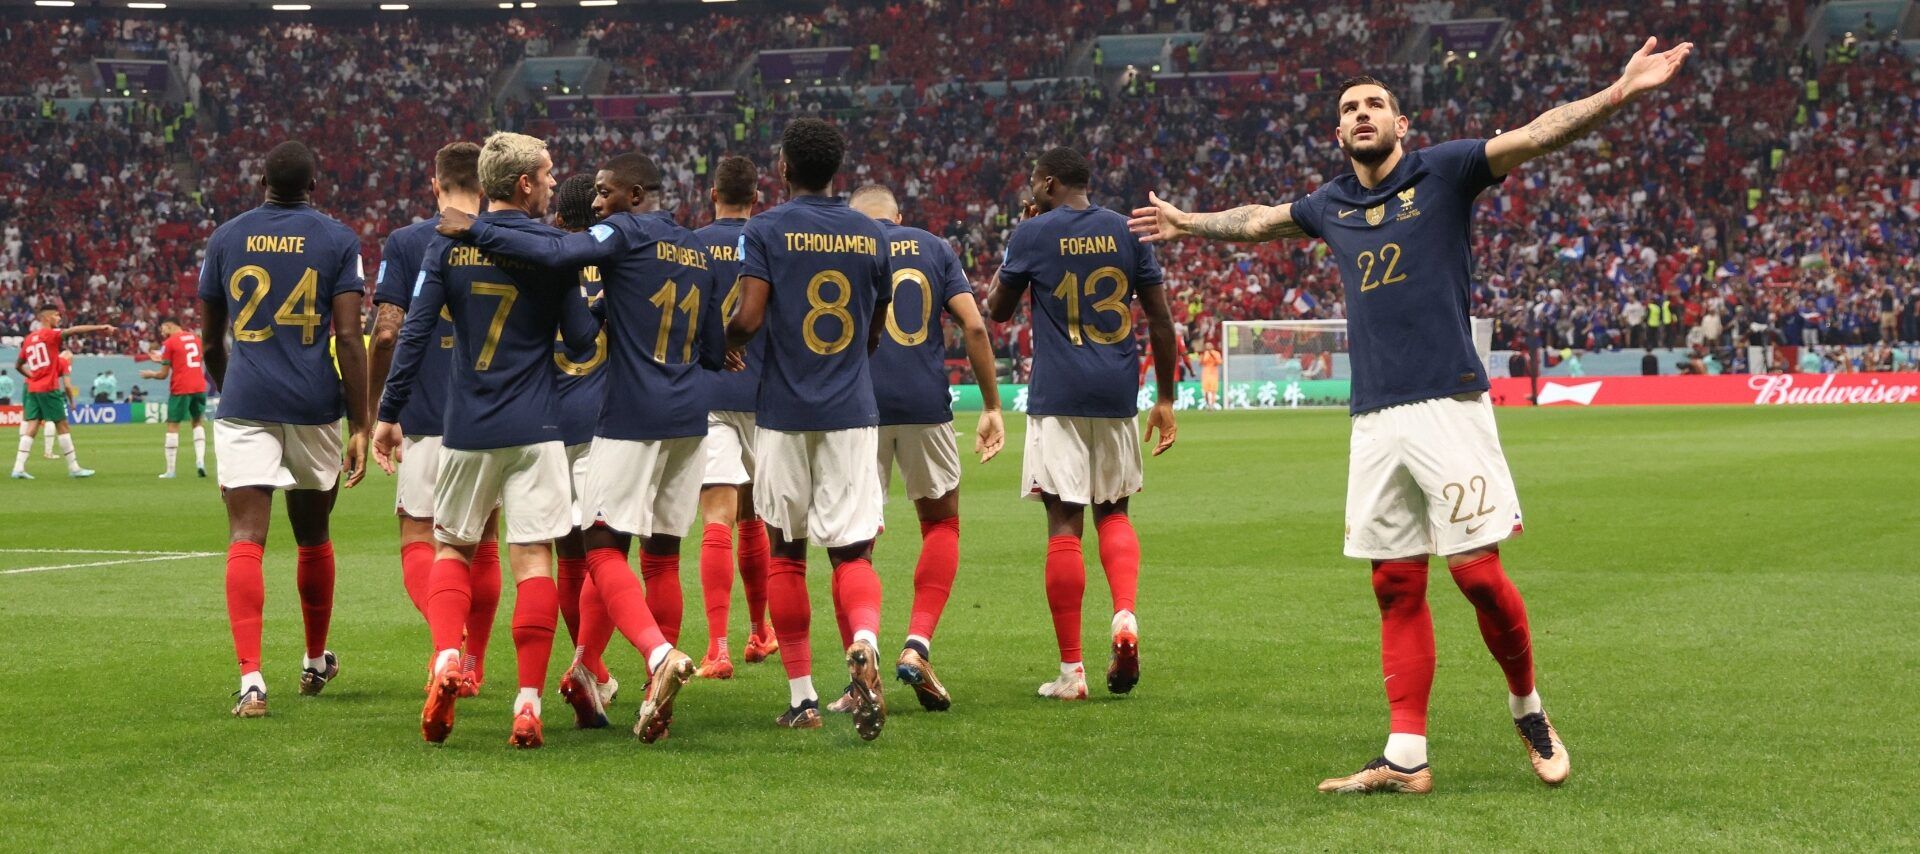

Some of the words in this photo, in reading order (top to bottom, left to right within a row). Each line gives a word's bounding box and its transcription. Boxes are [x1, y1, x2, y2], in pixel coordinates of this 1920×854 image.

[246, 235, 306, 254] KONATE
[656, 240, 708, 271] DEMBELE
[784, 232, 878, 257] TCHOUAMENI
[889, 239, 920, 257] PPE
[1059, 235, 1118, 256] FOFANA
[1357, 242, 1408, 293] 22
[229, 264, 322, 345] 24
[802, 268, 855, 356] 8
[885, 267, 933, 347] 0
[1052, 266, 1133, 346] 13
[470, 281, 520, 371] 7
[648, 278, 700, 365] 11
[25, 341, 51, 372] 20
[184, 342, 201, 368] 2
[1747, 373, 1918, 406] Budweiser
[71, 403, 117, 424] vivo
[1442, 474, 1497, 524] 22
